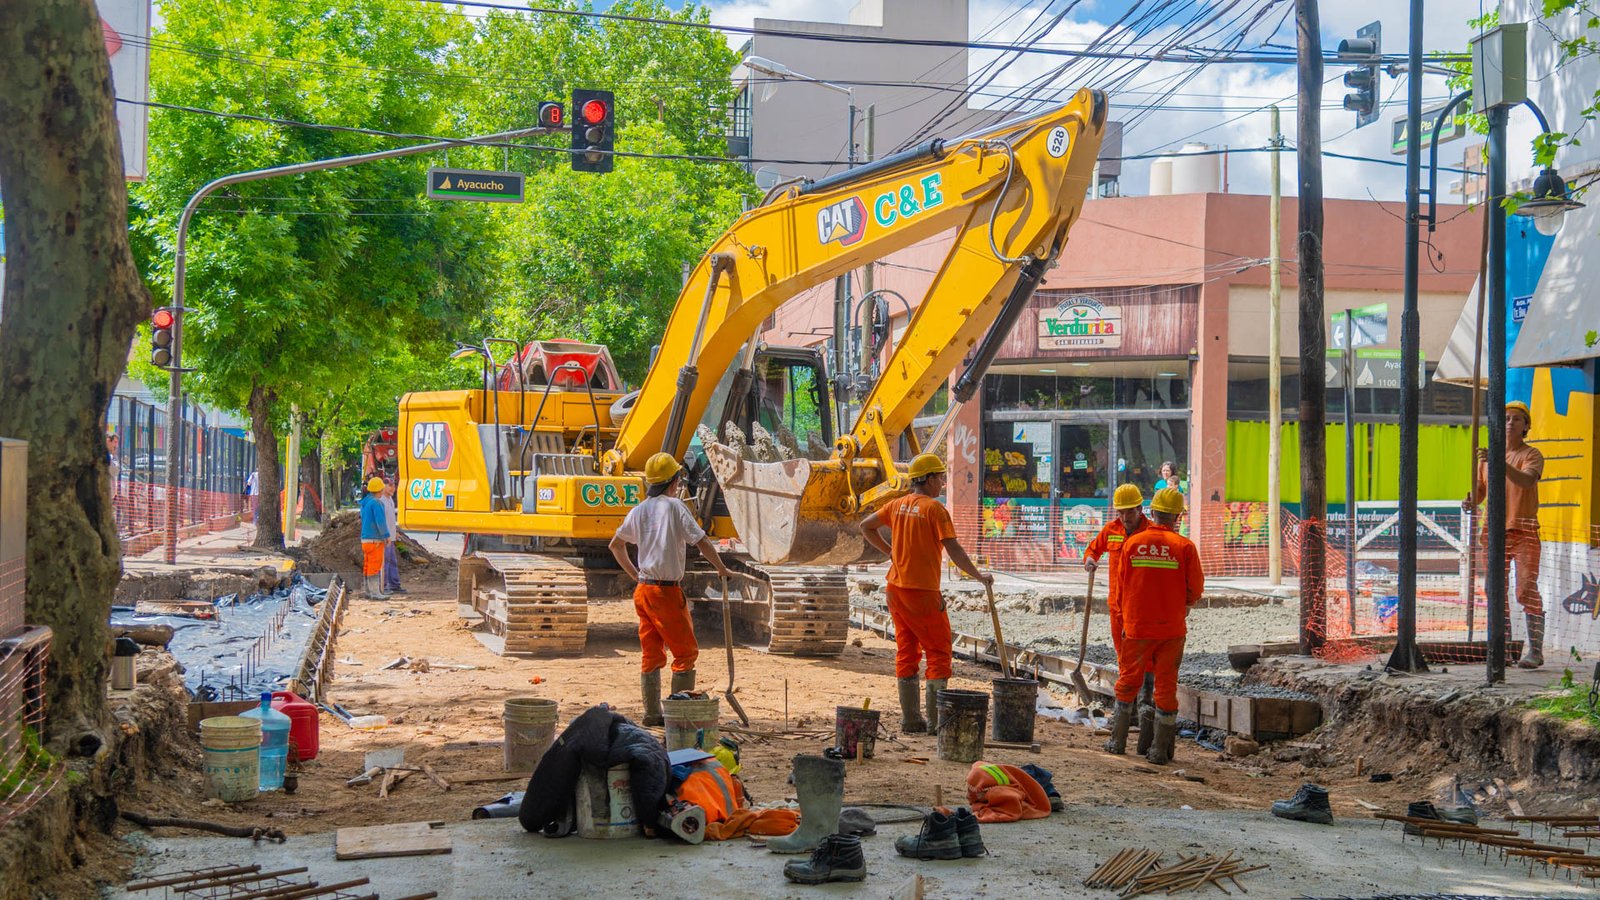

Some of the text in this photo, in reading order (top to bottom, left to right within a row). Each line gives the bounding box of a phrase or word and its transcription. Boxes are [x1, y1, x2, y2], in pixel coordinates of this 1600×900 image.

[1051, 129, 1065, 153] 528
[456, 178, 504, 191] Ayacucho
[873, 171, 944, 228] C&E
[818, 197, 855, 244] CAT
[1045, 317, 1114, 336] Verdurita
[1379, 379, 1397, 387] 1100
[413, 422, 445, 459] CAT
[410, 479, 445, 500] C&E
[538, 488, 552, 500] 320
[581, 483, 640, 507] C&E
[1326, 512, 1347, 521] rutas
